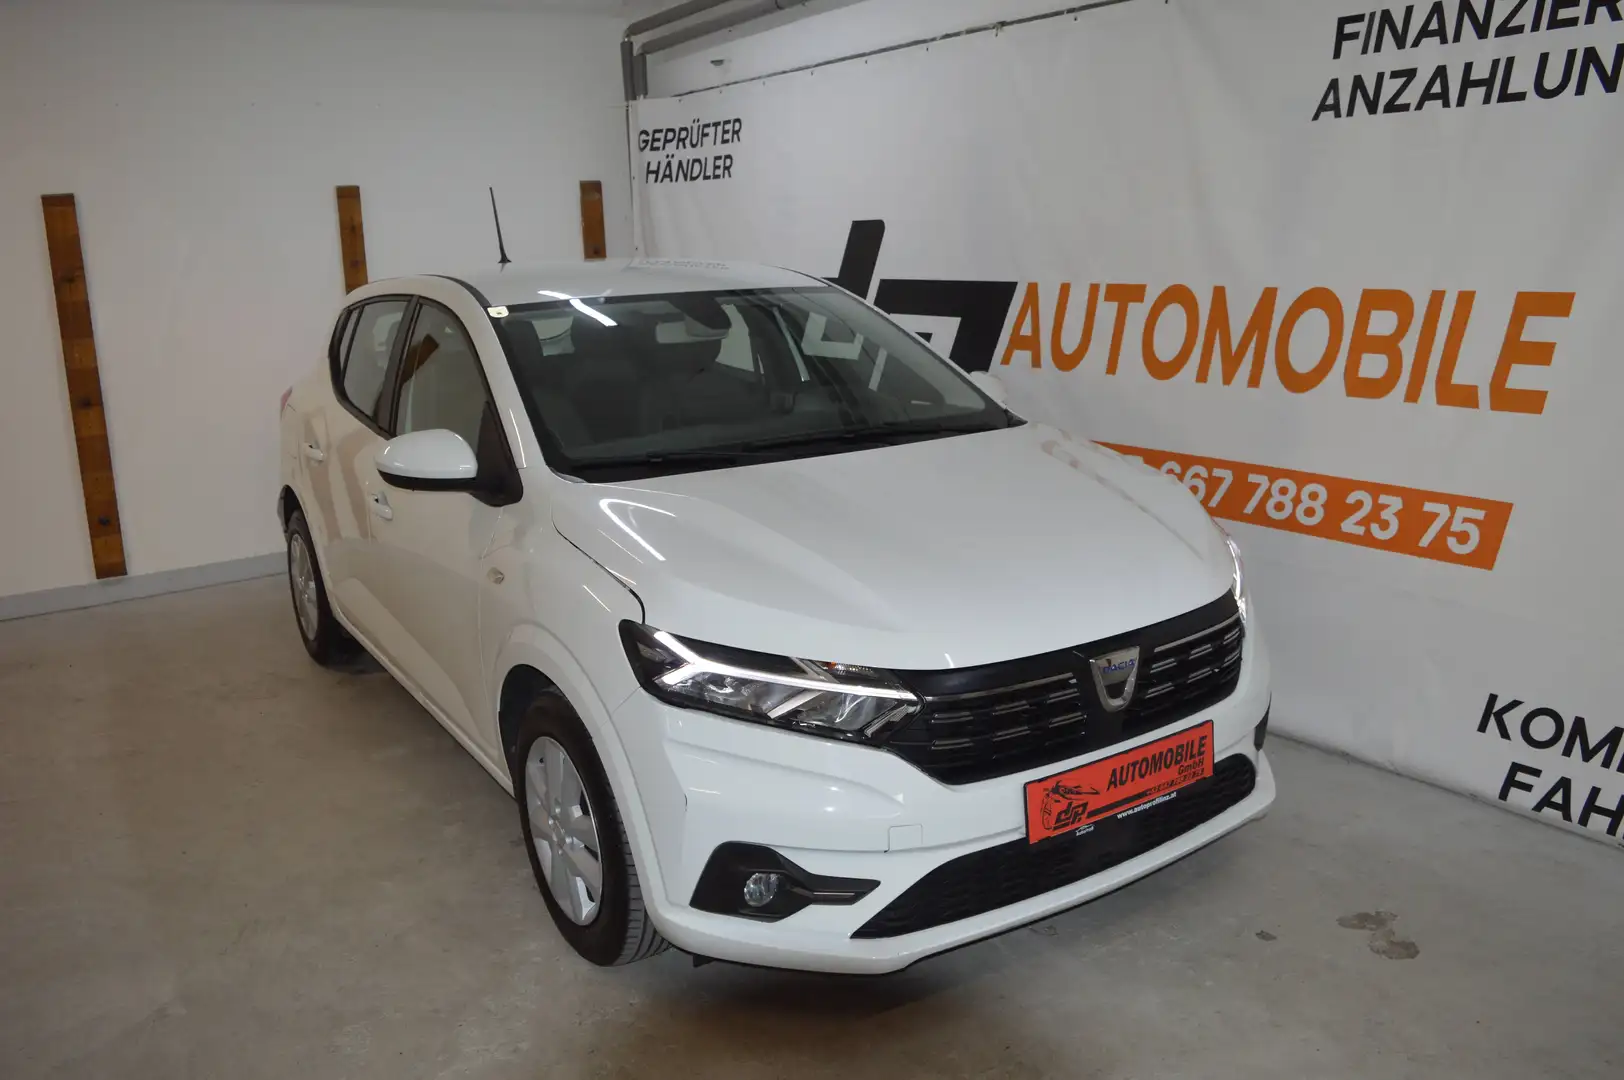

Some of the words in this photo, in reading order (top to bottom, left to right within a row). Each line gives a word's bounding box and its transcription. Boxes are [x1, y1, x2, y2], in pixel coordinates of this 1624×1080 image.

[1311, 43, 1624, 122] ANZAHLUN
[638, 117, 742, 153] GEPRÜFTER
[645, 154, 734, 184] HÄNDLER
[1001, 282, 1576, 415] AUTOMOBILE
[1243, 474, 1327, 526] 788
[1341, 490, 1400, 541] 23
[1418, 502, 1486, 556] 75
[1106, 735, 1208, 792] AUTOMOBILE
[1178, 758, 1204, 775] GmbH
[1498, 762, 1624, 840] FAH
